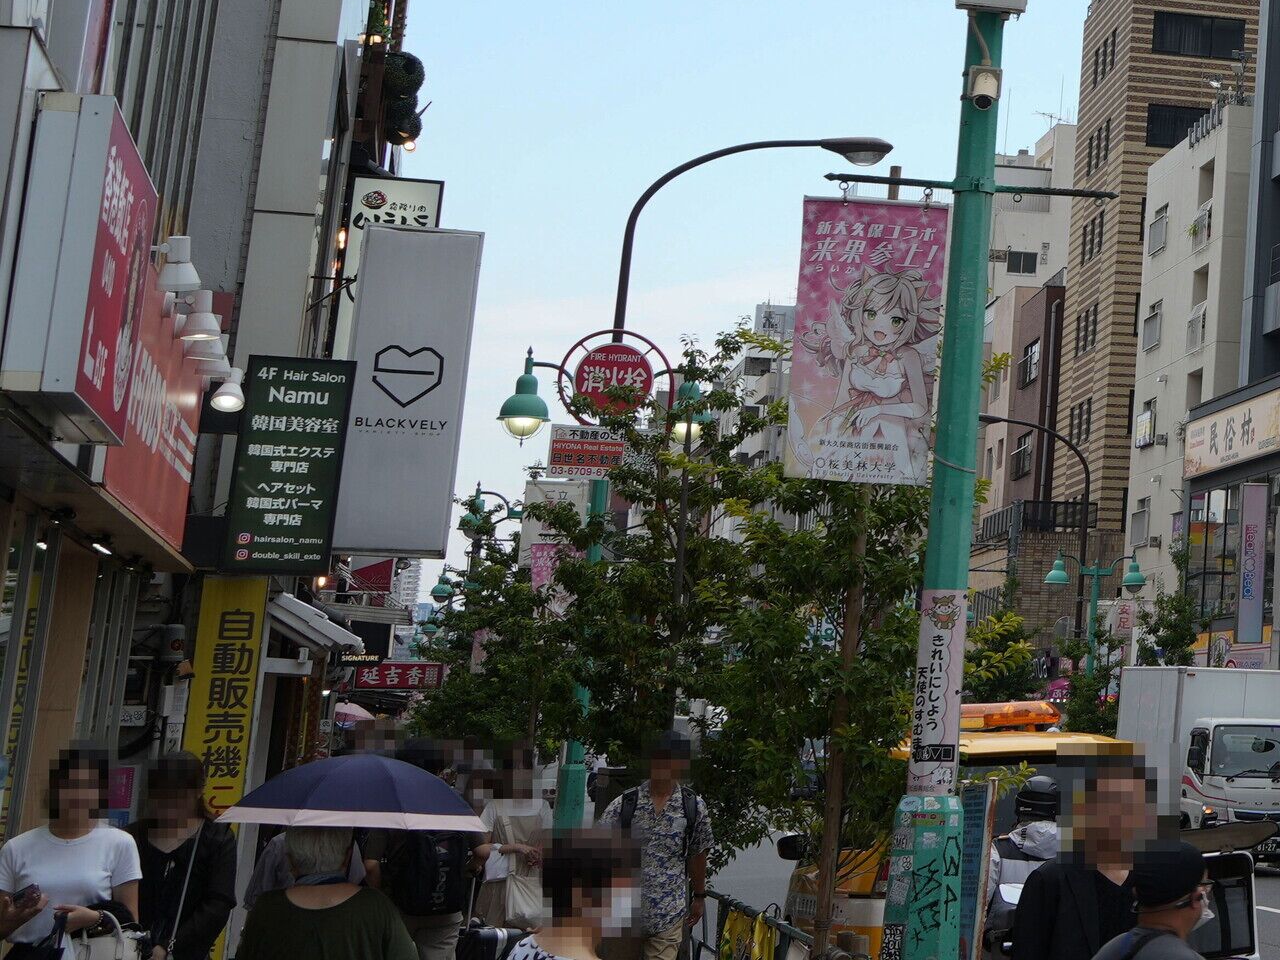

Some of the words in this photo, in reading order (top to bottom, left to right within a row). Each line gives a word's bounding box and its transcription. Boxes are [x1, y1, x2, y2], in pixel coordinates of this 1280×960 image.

[815, 220, 937, 241] 新大久保コラボ
[590, 352, 607, 362] FIRE
[608, 353, 642, 363] HYDRANT
[257, 366, 279, 381] 4F
[283, 371, 308, 383] Hair
[312, 372, 346, 384] Salon
[581, 364, 648, 393] 消火栓
[268, 386, 330, 406] Namu
[251, 414, 340, 435] 韓国美容室
[354, 416, 448, 432] BLACKVELY
[1209, 407, 1253, 456] 民俗村
[247, 442, 336, 459] 韓国式エクステ
[553, 442, 582, 451] HIYONA
[583, 443, 599, 451] Real
[270, 460, 310, 474] 専門店
[829, 460, 896, 473] 桜美林大学
[257, 482, 316, 495] ヘアセット
[263, 512, 303, 527] 専門店
[254, 535, 323, 545] hairsalon_namu
[341, 654, 380, 662] SIGNATURE
[360, 665, 425, 686] 延吉香
[926, 634, 944, 731] きれいにしよう
[201, 608, 256, 778] 自動販売機
